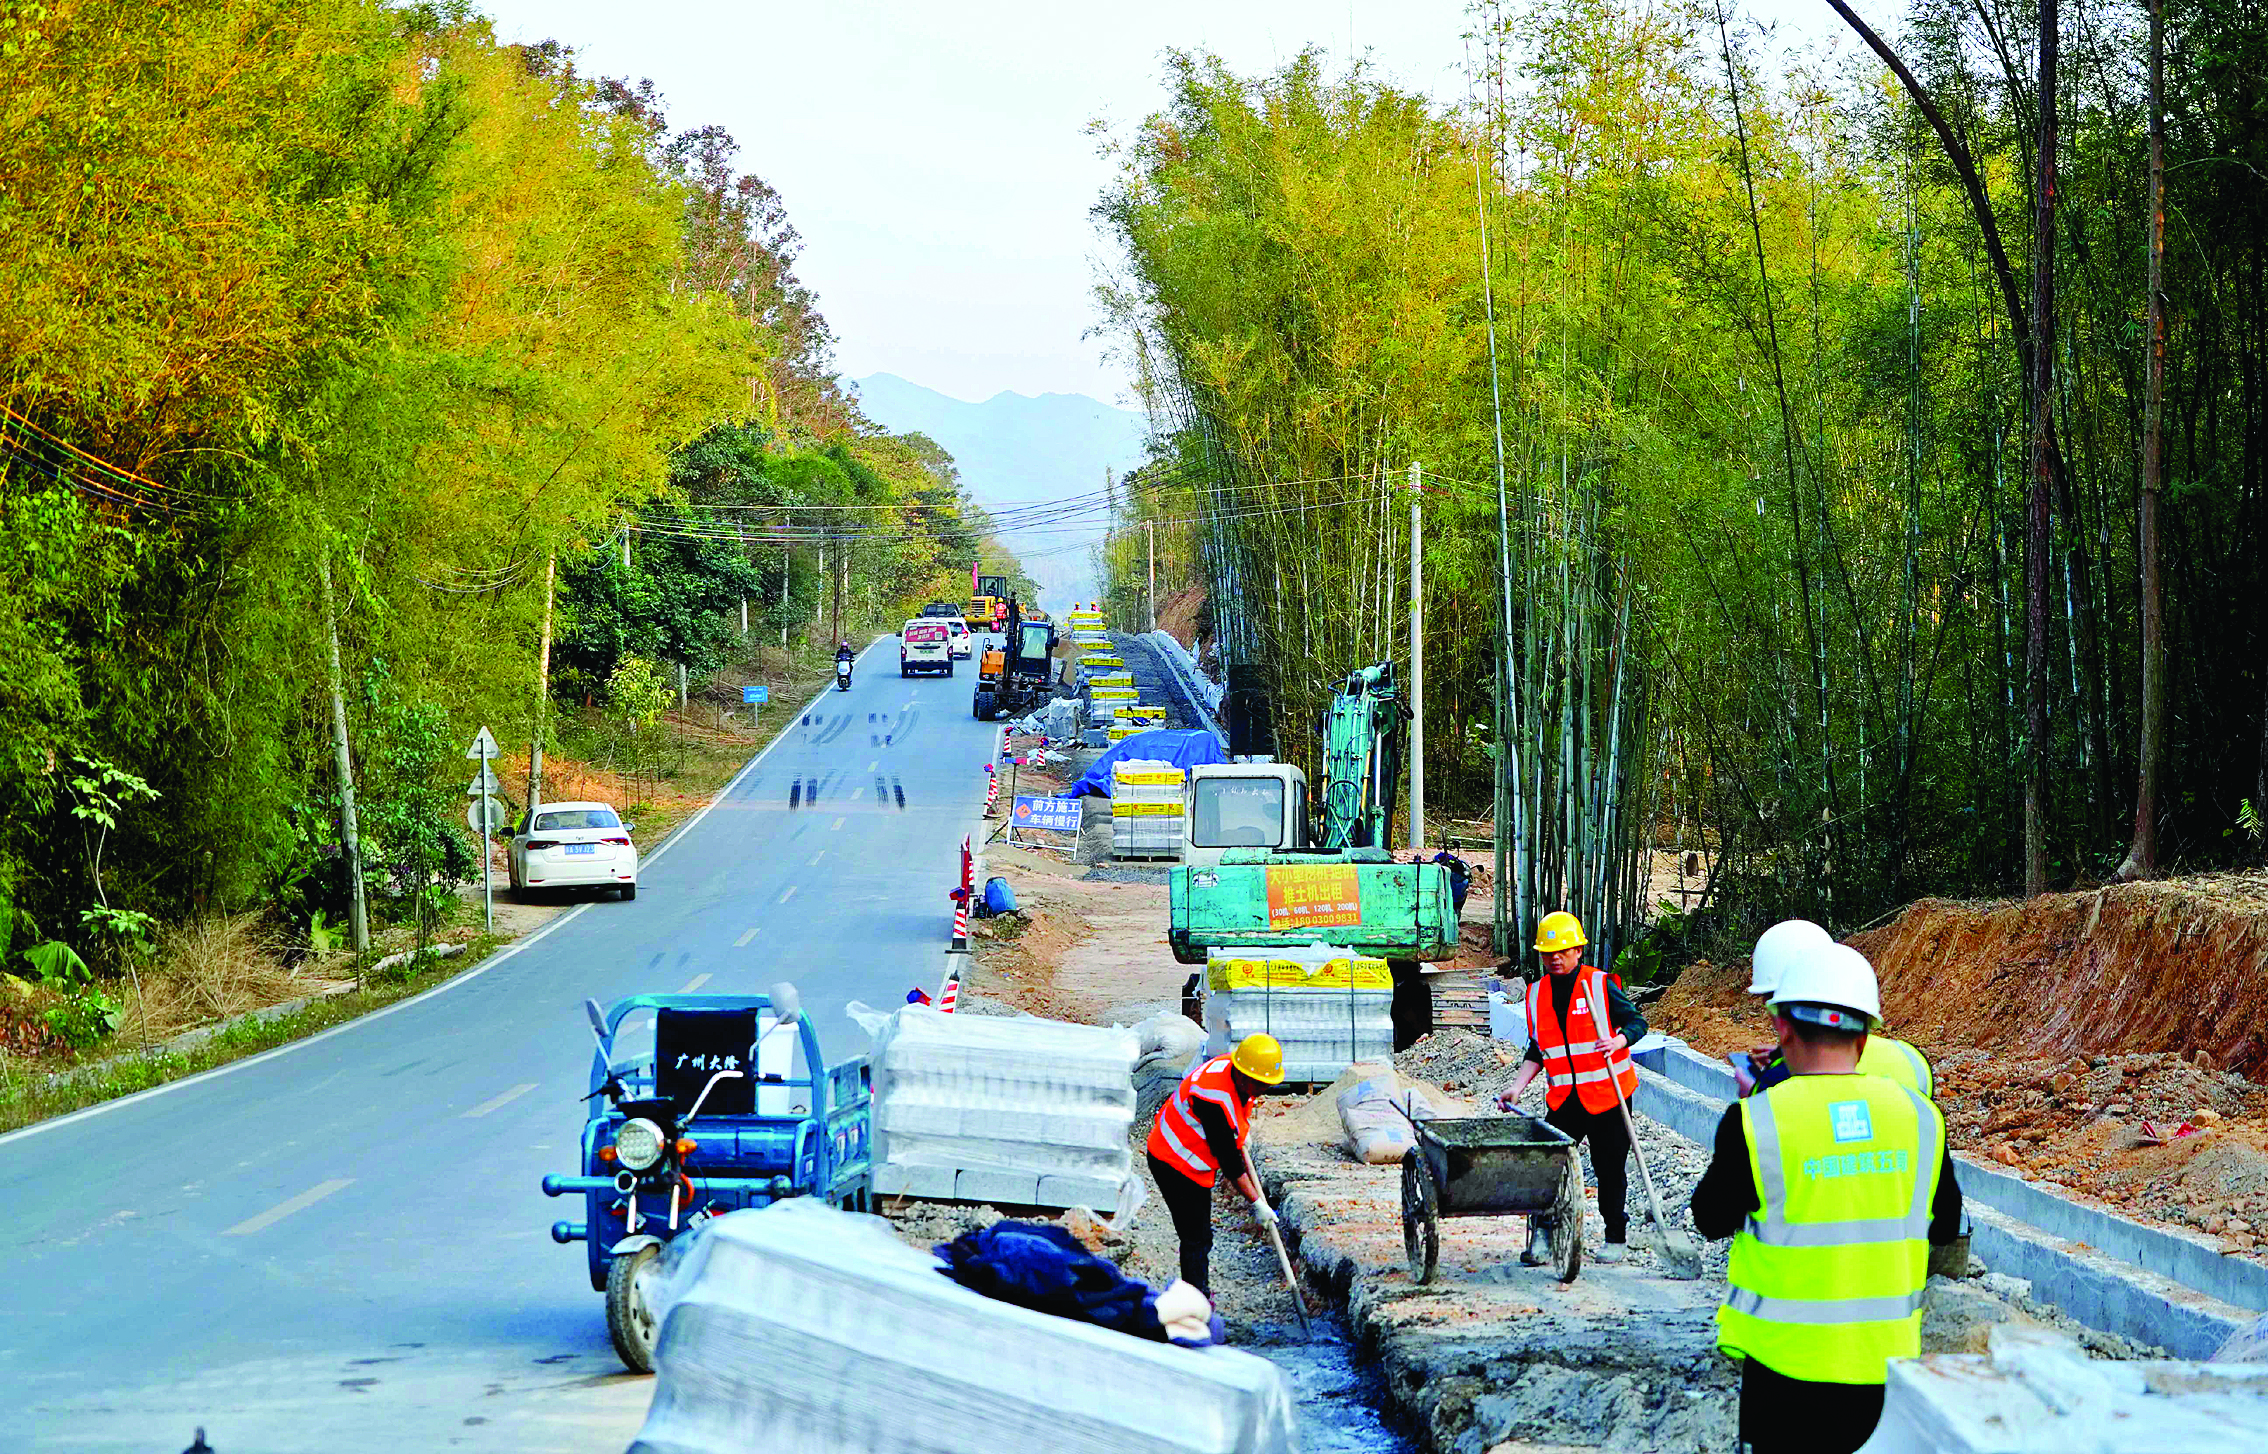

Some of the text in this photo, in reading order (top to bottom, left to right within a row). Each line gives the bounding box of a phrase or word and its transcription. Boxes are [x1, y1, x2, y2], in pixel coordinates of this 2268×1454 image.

[1032, 799, 1079, 813] 前方施工
[1030, 814, 1078, 827] 车辆慢行
[1283, 882, 1343, 904] 推土机出租
